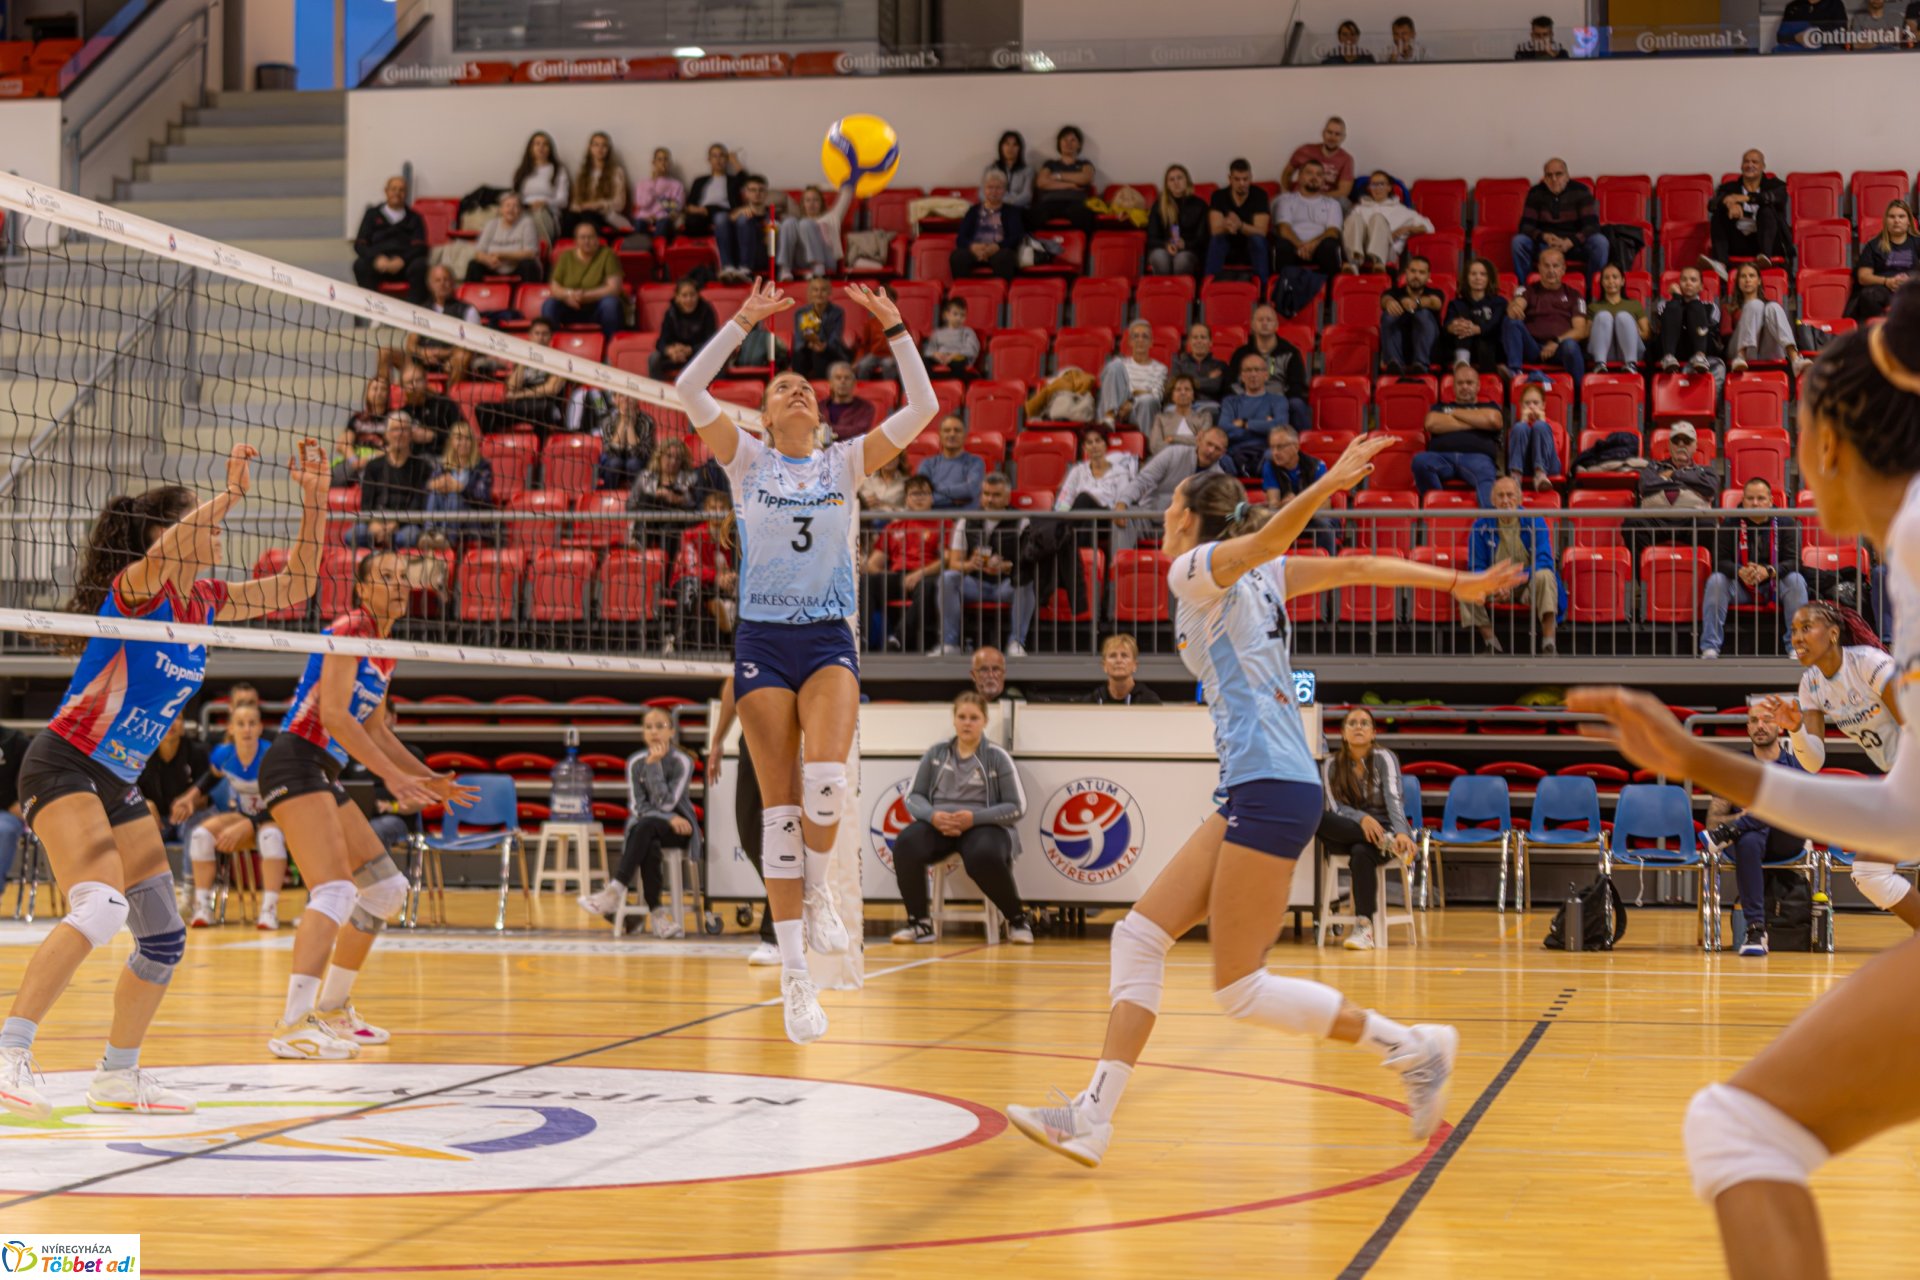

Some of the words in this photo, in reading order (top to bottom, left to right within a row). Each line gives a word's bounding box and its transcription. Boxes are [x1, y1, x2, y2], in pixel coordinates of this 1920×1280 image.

[1637, 29, 1733, 53] Continental
[1803, 26, 1900, 48] Continental
[381, 62, 467, 84] Continental
[529, 57, 618, 80] Continental
[682, 55, 771, 77] Continental
[835, 51, 925, 74] Continental
[791, 516, 814, 553] 3
[741, 662, 760, 679] 3
[160, 685, 193, 718] 2
[120, 706, 167, 742] FATU
[1066, 780, 1119, 796] FATUM
[160, 1080, 805, 1107] NYÍREGYHÁZ
